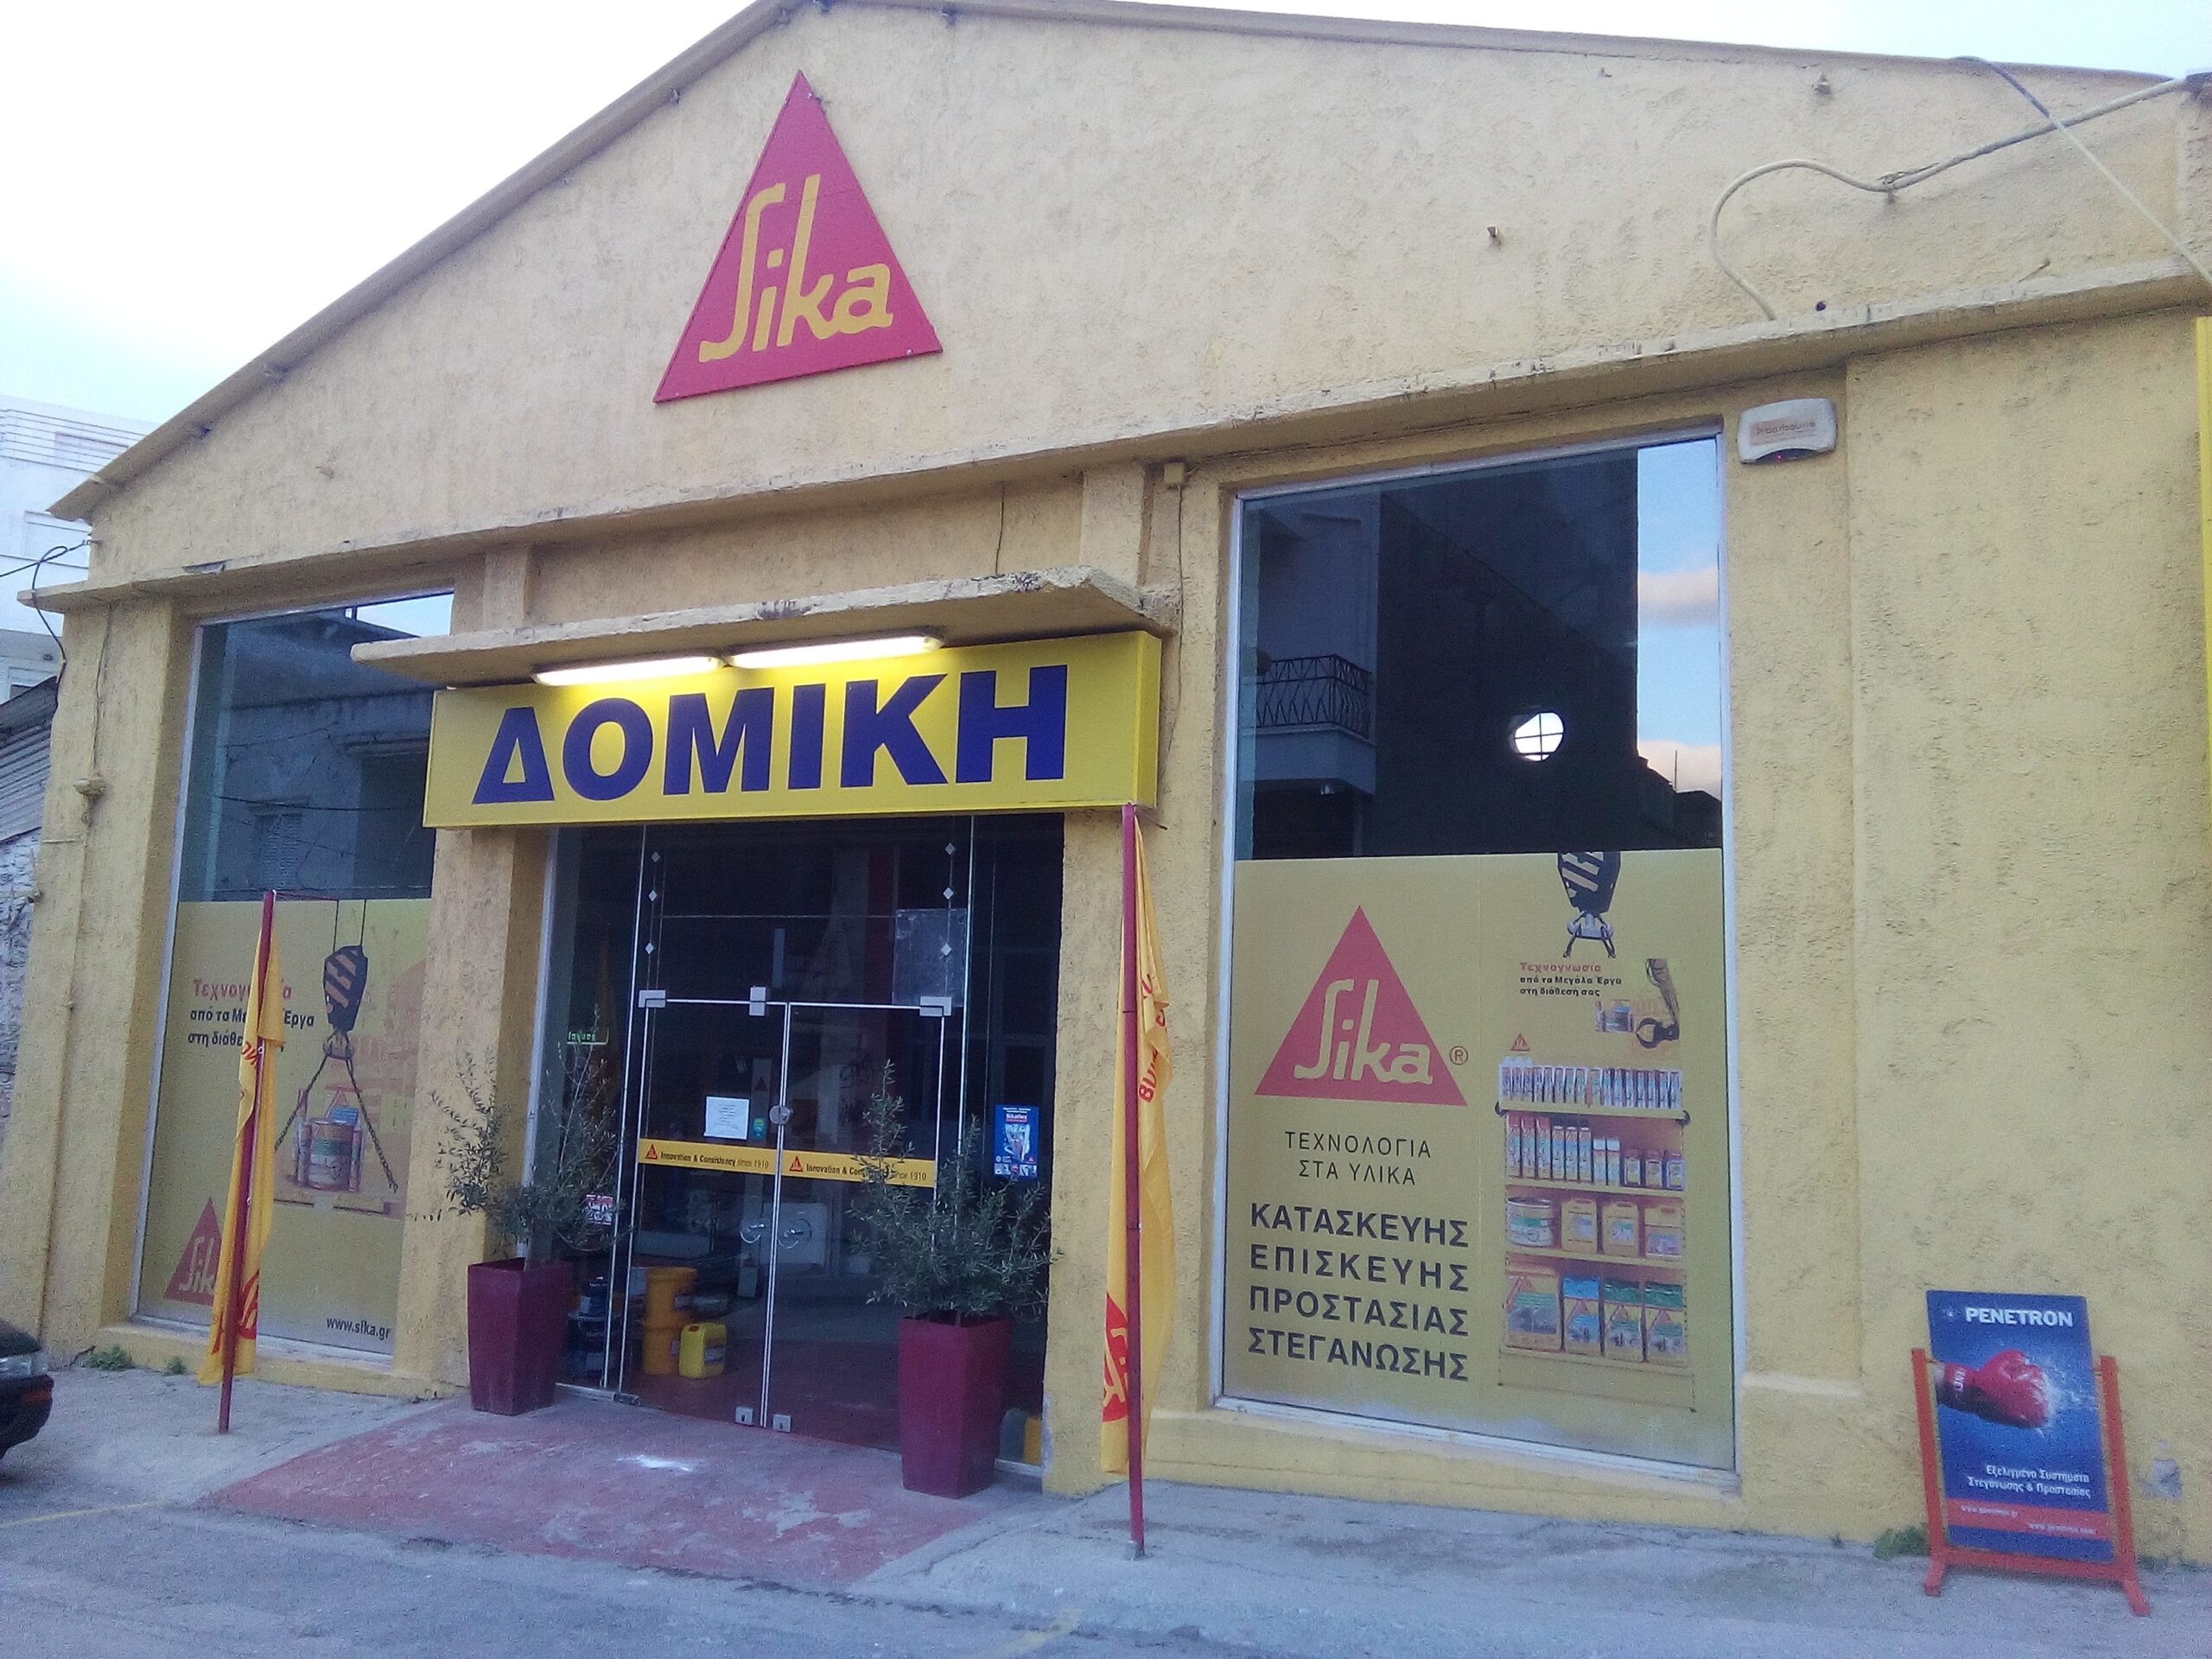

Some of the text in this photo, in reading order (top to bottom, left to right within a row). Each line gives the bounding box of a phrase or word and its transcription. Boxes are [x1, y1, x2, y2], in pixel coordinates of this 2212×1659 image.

[698, 174, 893, 362] Sika
[472, 663, 1069, 804] ΔΟΜΙΚΗ
[1520, 975, 1539, 983] από
[1555, 976, 1592, 985] Μεγάλα
[1520, 988, 1537, 996] στη
[190, 1007, 213, 1021] από
[217, 1010, 229, 1021] τα
[188, 1032, 208, 1047] στη
[1294, 979, 1433, 1085] Sika
[1285, 1131, 1431, 1158] ΤΕΧΝΟΛΟΓΙΑ
[660, 1151, 691, 1161] Innovation
[699, 1154, 735, 1166] Consistency
[754, 1160, 769, 1169] 1910
[806, 1163, 840, 1174] Innovation
[910, 1171, 926, 1180] 1910
[1299, 1160, 1415, 1185] ΣΤΑ ΥΛΙΚΑ
[1251, 1203, 1469, 1248] ΚΑΤΑΣΚΕΥΗΣ
[1250, 1244, 1469, 1292] ΕΠΙΣΚΕΥΗΣ
[1249, 1285, 1469, 1337] ΠΡΟΣΤΑΣΙΑΣ
[1965, 1307, 2074, 1328] PENETRON
[327, 1318, 391, 1341] www.sika.gr
[1248, 1327, 1469, 1382] ΣΤΕΓΑΝΩΣΗΣ
